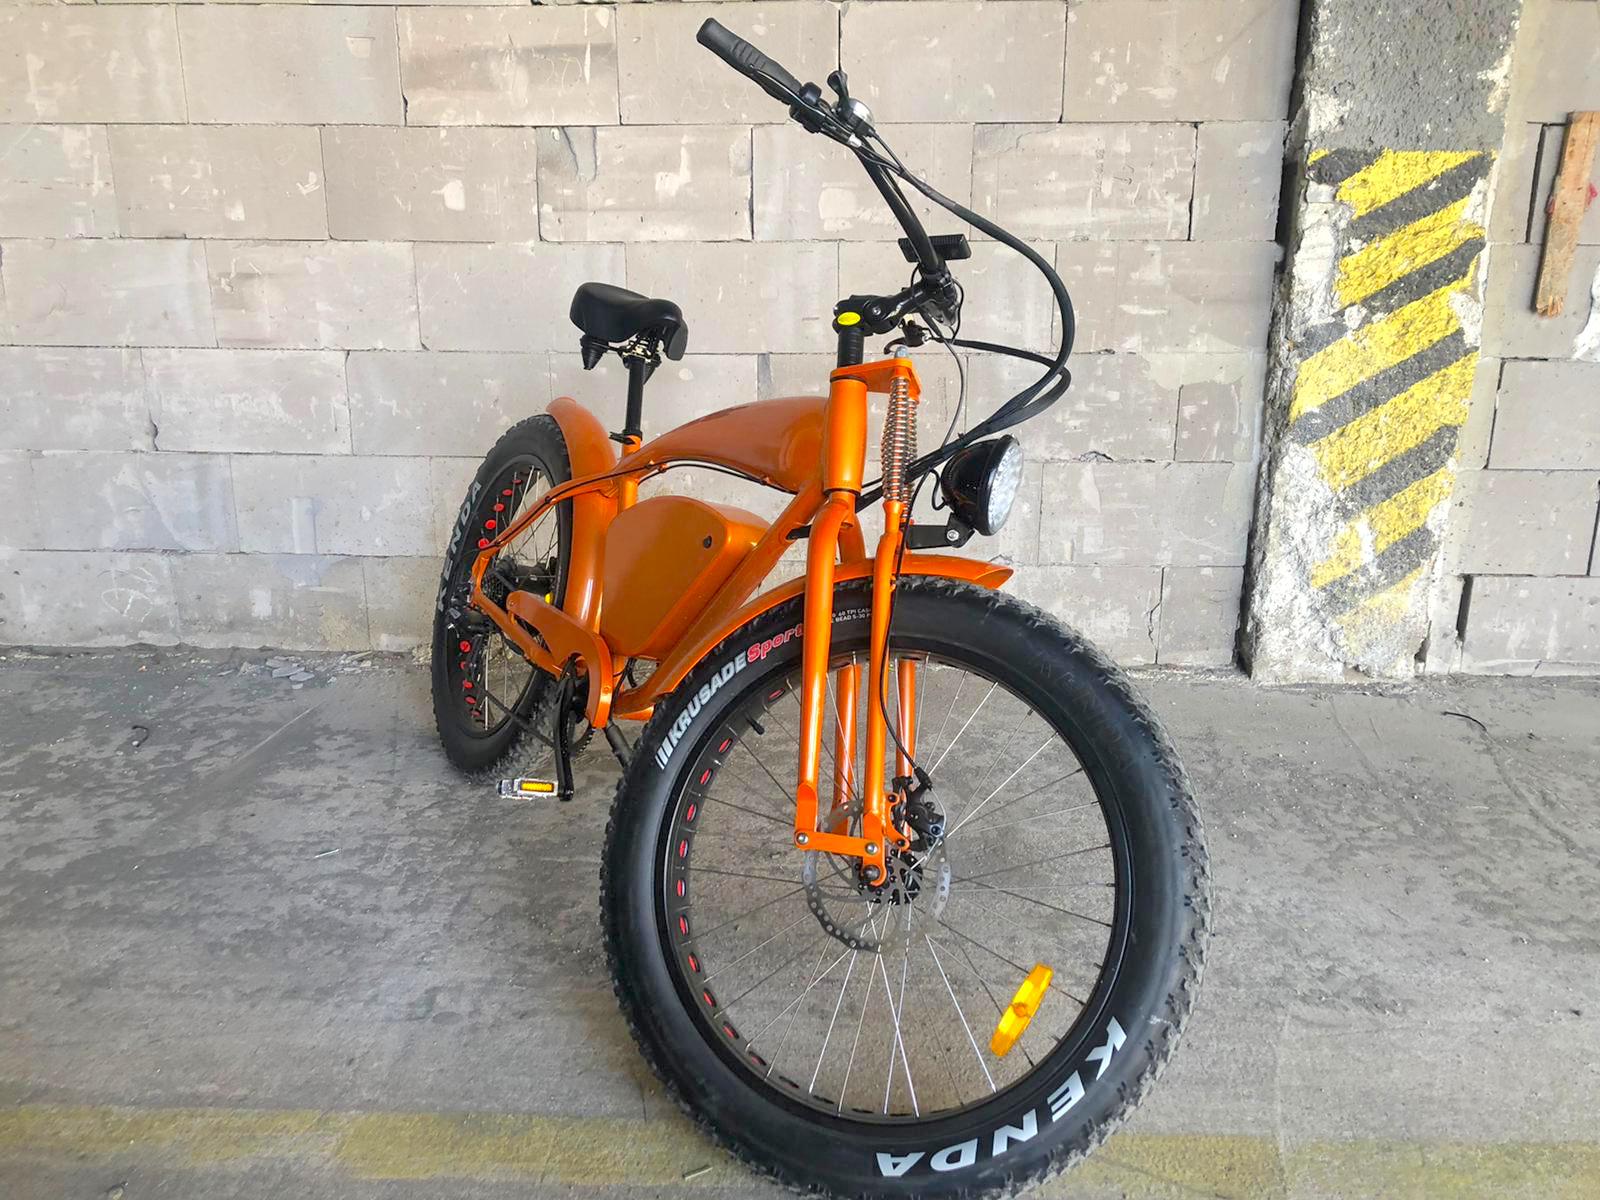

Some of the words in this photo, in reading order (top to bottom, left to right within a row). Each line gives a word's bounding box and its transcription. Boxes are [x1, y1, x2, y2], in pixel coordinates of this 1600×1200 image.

[835, 614, 852, 622] BEAD
[667, 651, 747, 742] KRUSADE
[747, 623, 804, 662] Sport
[876, 1016, 1128, 1177] KENDA
